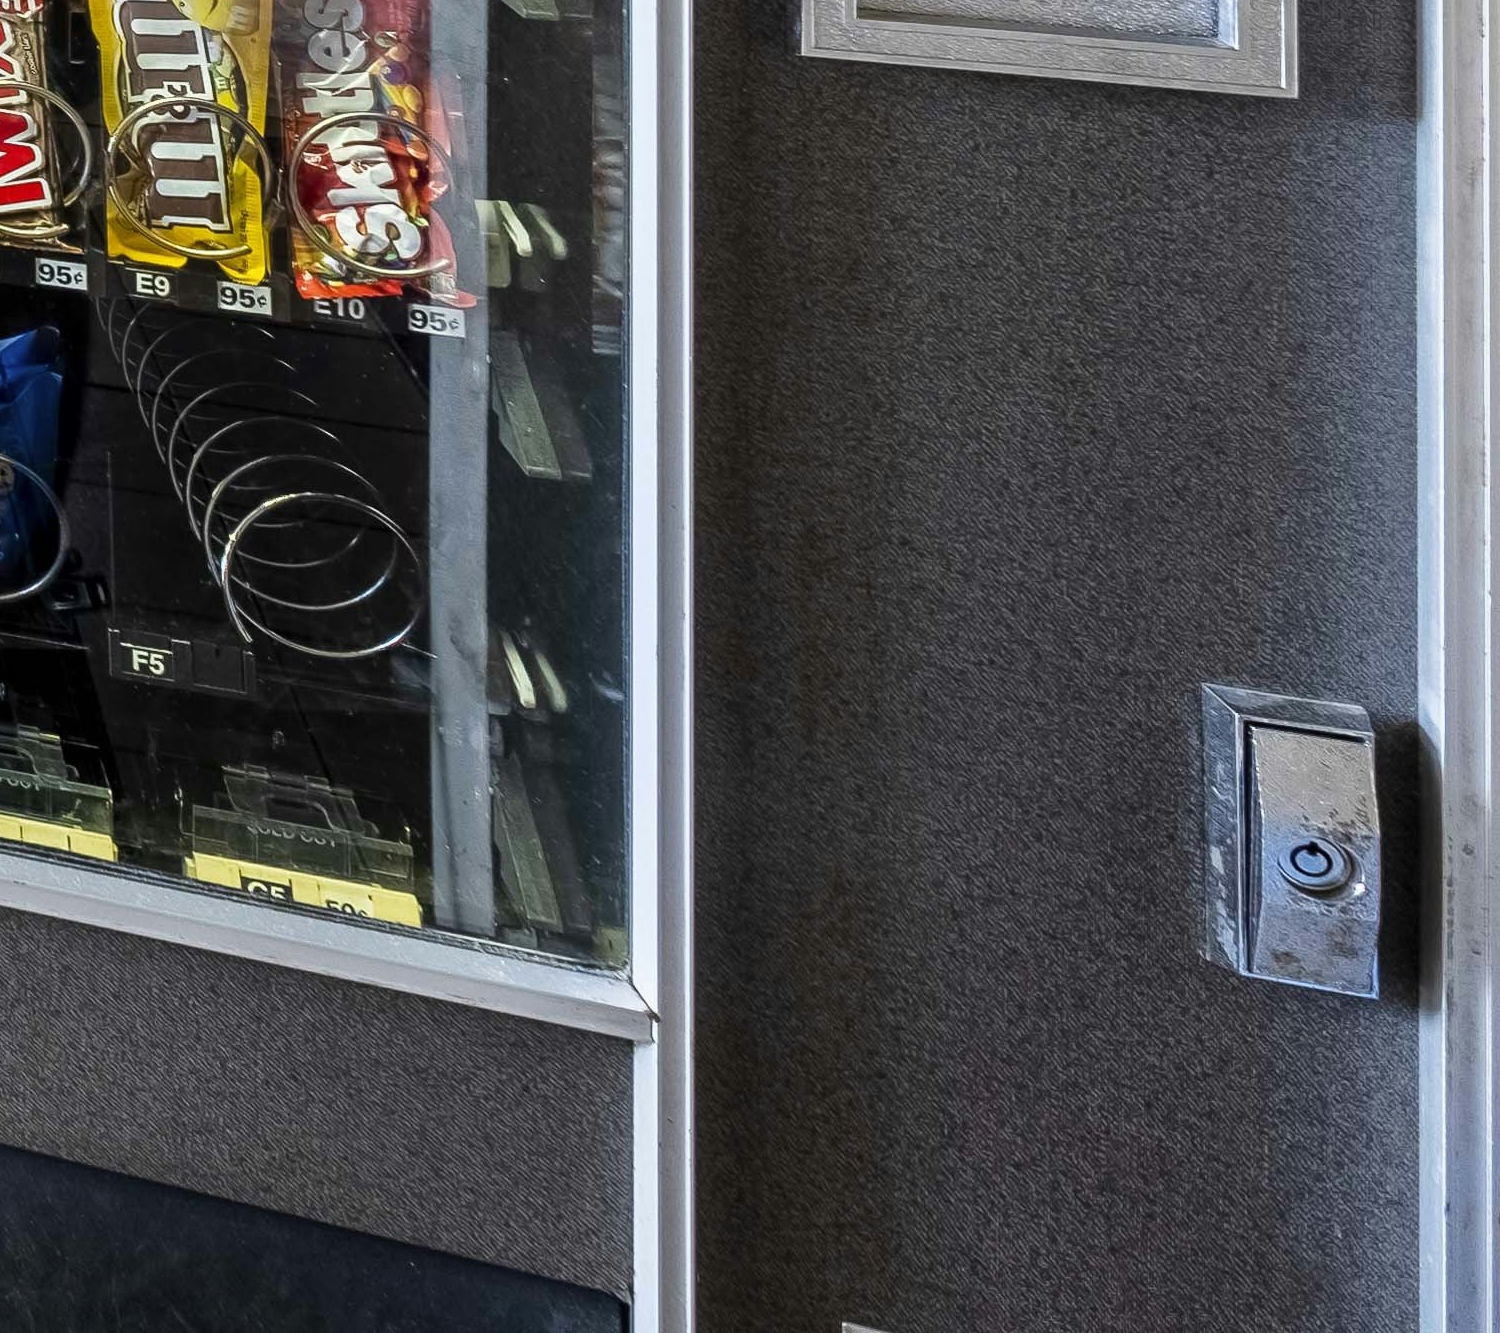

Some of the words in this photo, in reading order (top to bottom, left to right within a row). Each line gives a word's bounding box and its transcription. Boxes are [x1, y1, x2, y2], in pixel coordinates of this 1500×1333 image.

[136, 273, 169, 296] E9
[313, 297, 366, 320] E10
[132, 649, 165, 675] F5
